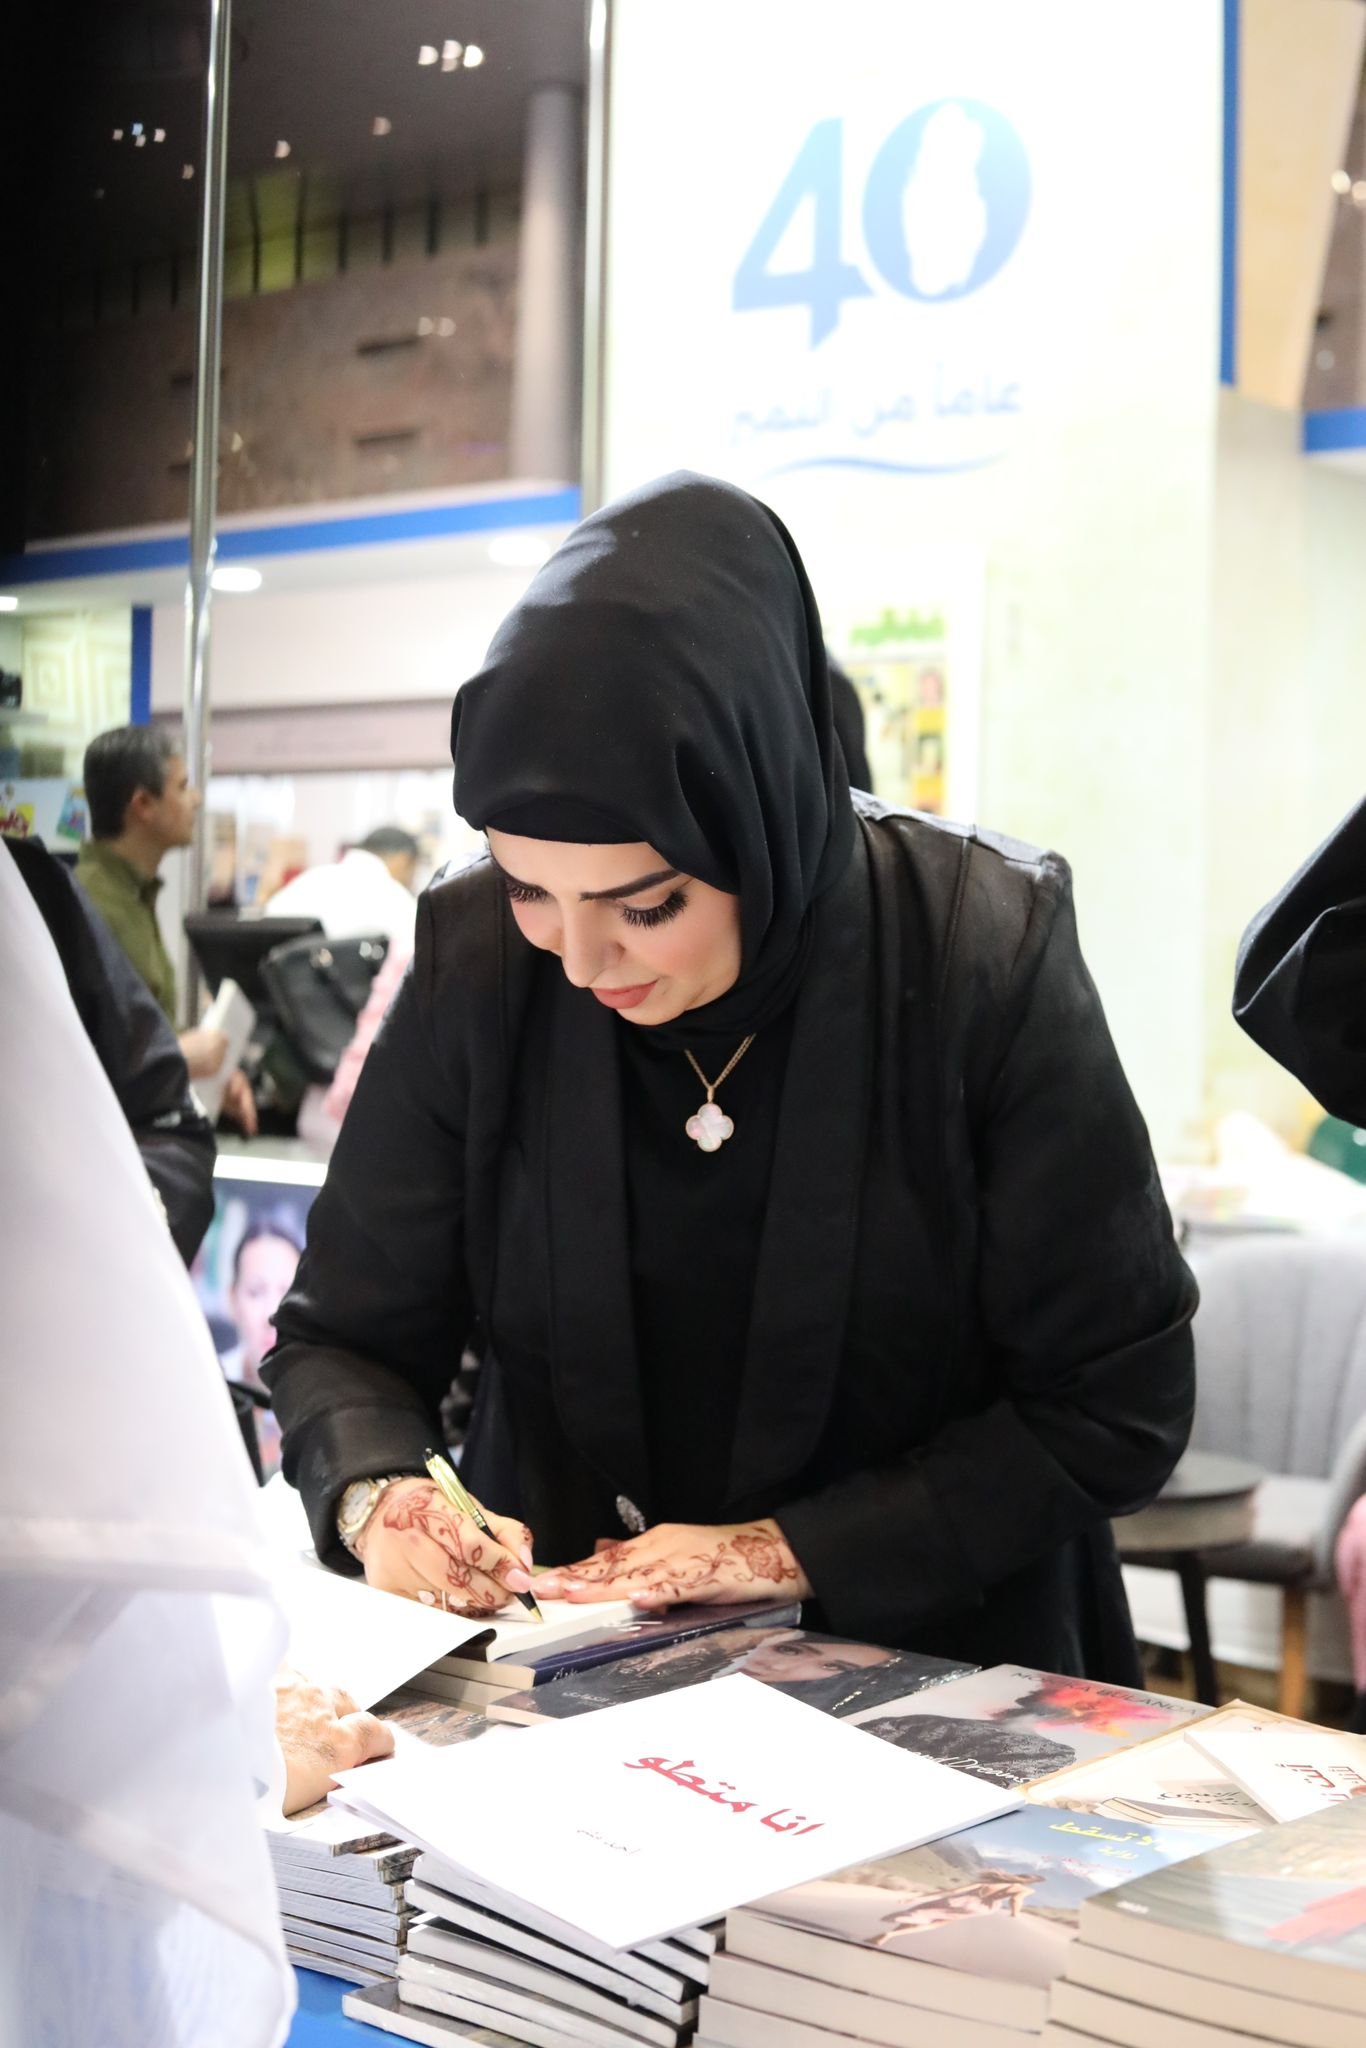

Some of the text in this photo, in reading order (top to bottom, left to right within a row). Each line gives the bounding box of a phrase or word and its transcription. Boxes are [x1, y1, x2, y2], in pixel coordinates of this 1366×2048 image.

[730, 95, 1034, 352] 40
[948, 1757, 1032, 1784] Dreams
[760, 1808, 825, 1836] انا
